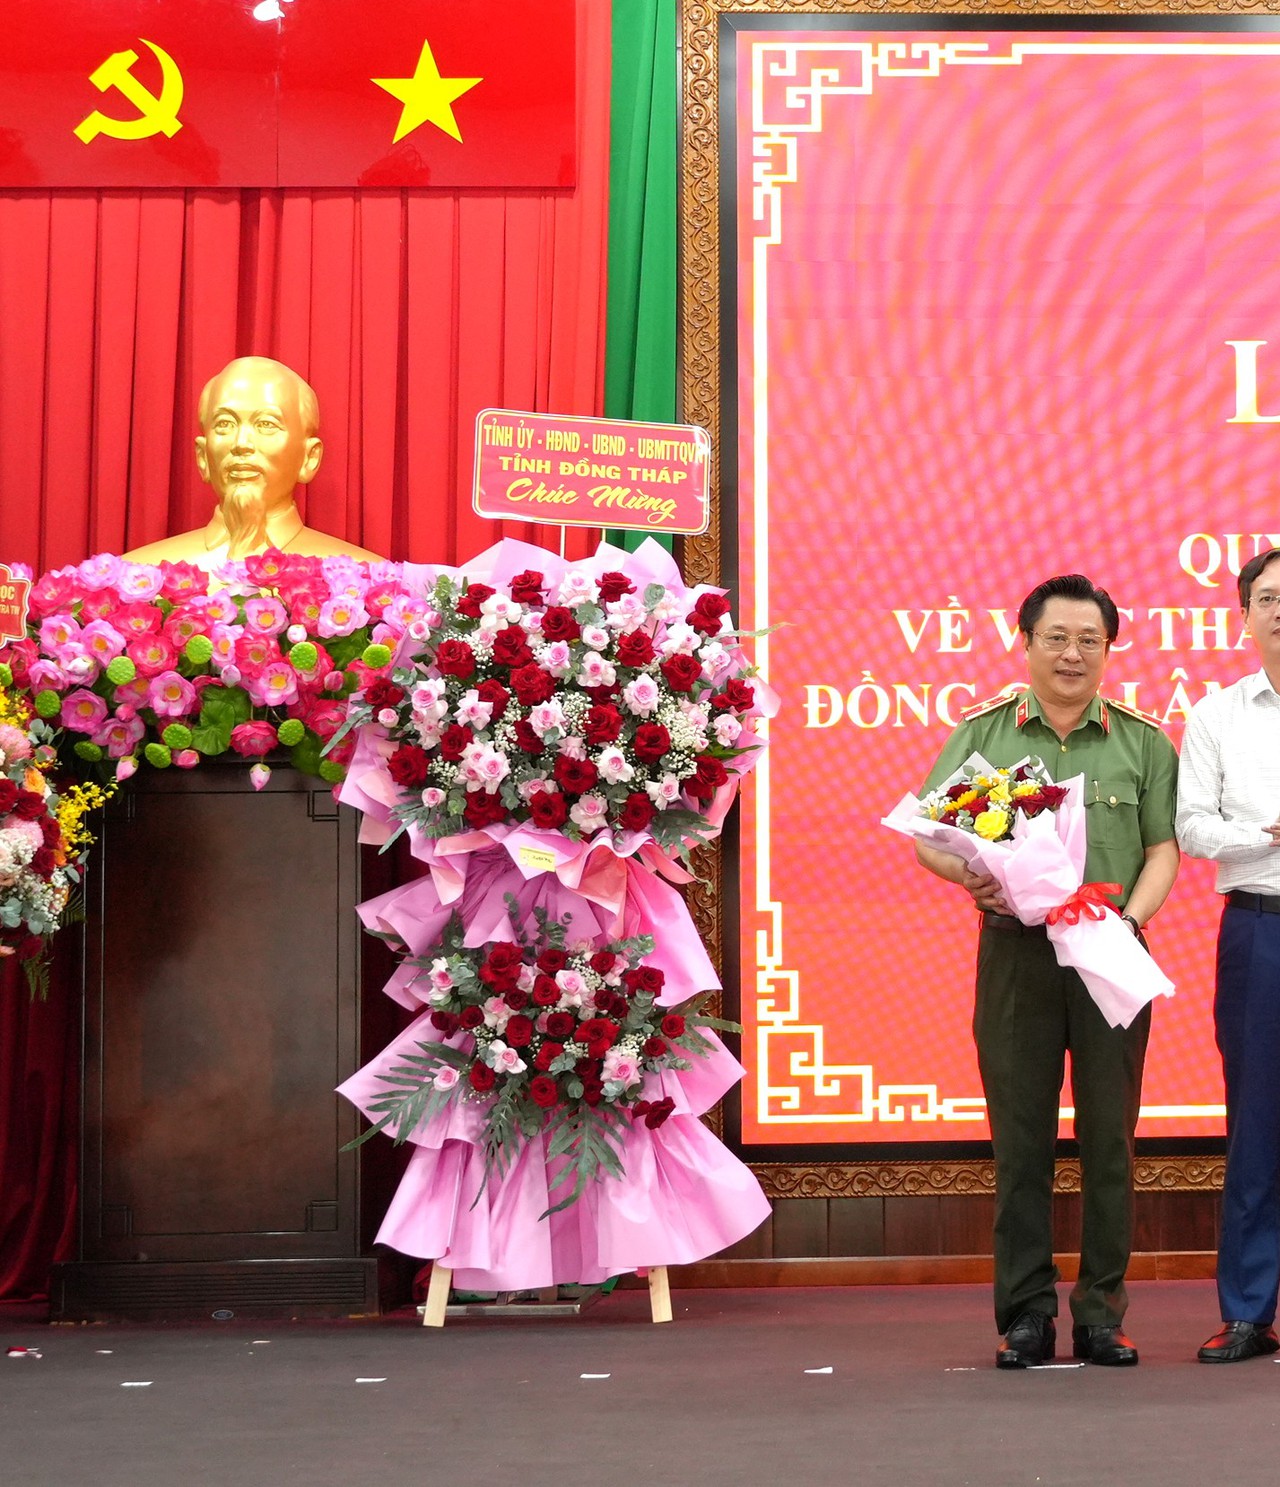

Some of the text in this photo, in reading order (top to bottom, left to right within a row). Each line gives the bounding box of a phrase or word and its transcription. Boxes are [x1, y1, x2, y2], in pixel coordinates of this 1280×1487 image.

[484, 418, 513, 447] TỈNH
[517, 419, 535, 449] ỦY
[546, 430, 581, 453] HĐND
[592, 434, 626, 456] UBND
[499, 452, 688, 485] TỈNH ĐỒNG THÁP
[506, 477, 678, 524] Chúc Mừng
[892, 595, 973, 653] VỀ
[1121, 667, 1223, 724] LÂ
